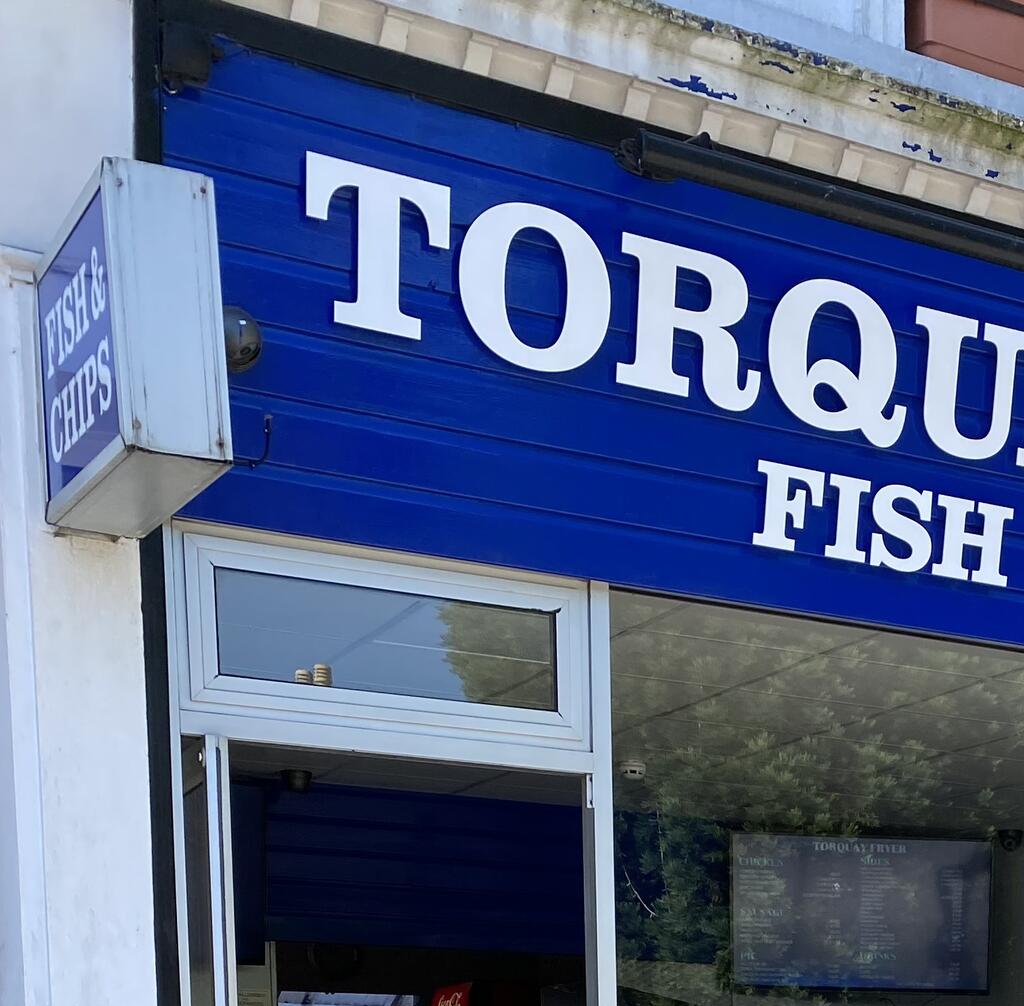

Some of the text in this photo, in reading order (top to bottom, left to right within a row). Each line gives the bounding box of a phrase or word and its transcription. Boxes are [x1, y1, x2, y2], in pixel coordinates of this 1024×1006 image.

[44, 246, 106, 380] FISH &
[50, 336, 112, 464] CHIPS
[752, 459, 1015, 588] FISH
